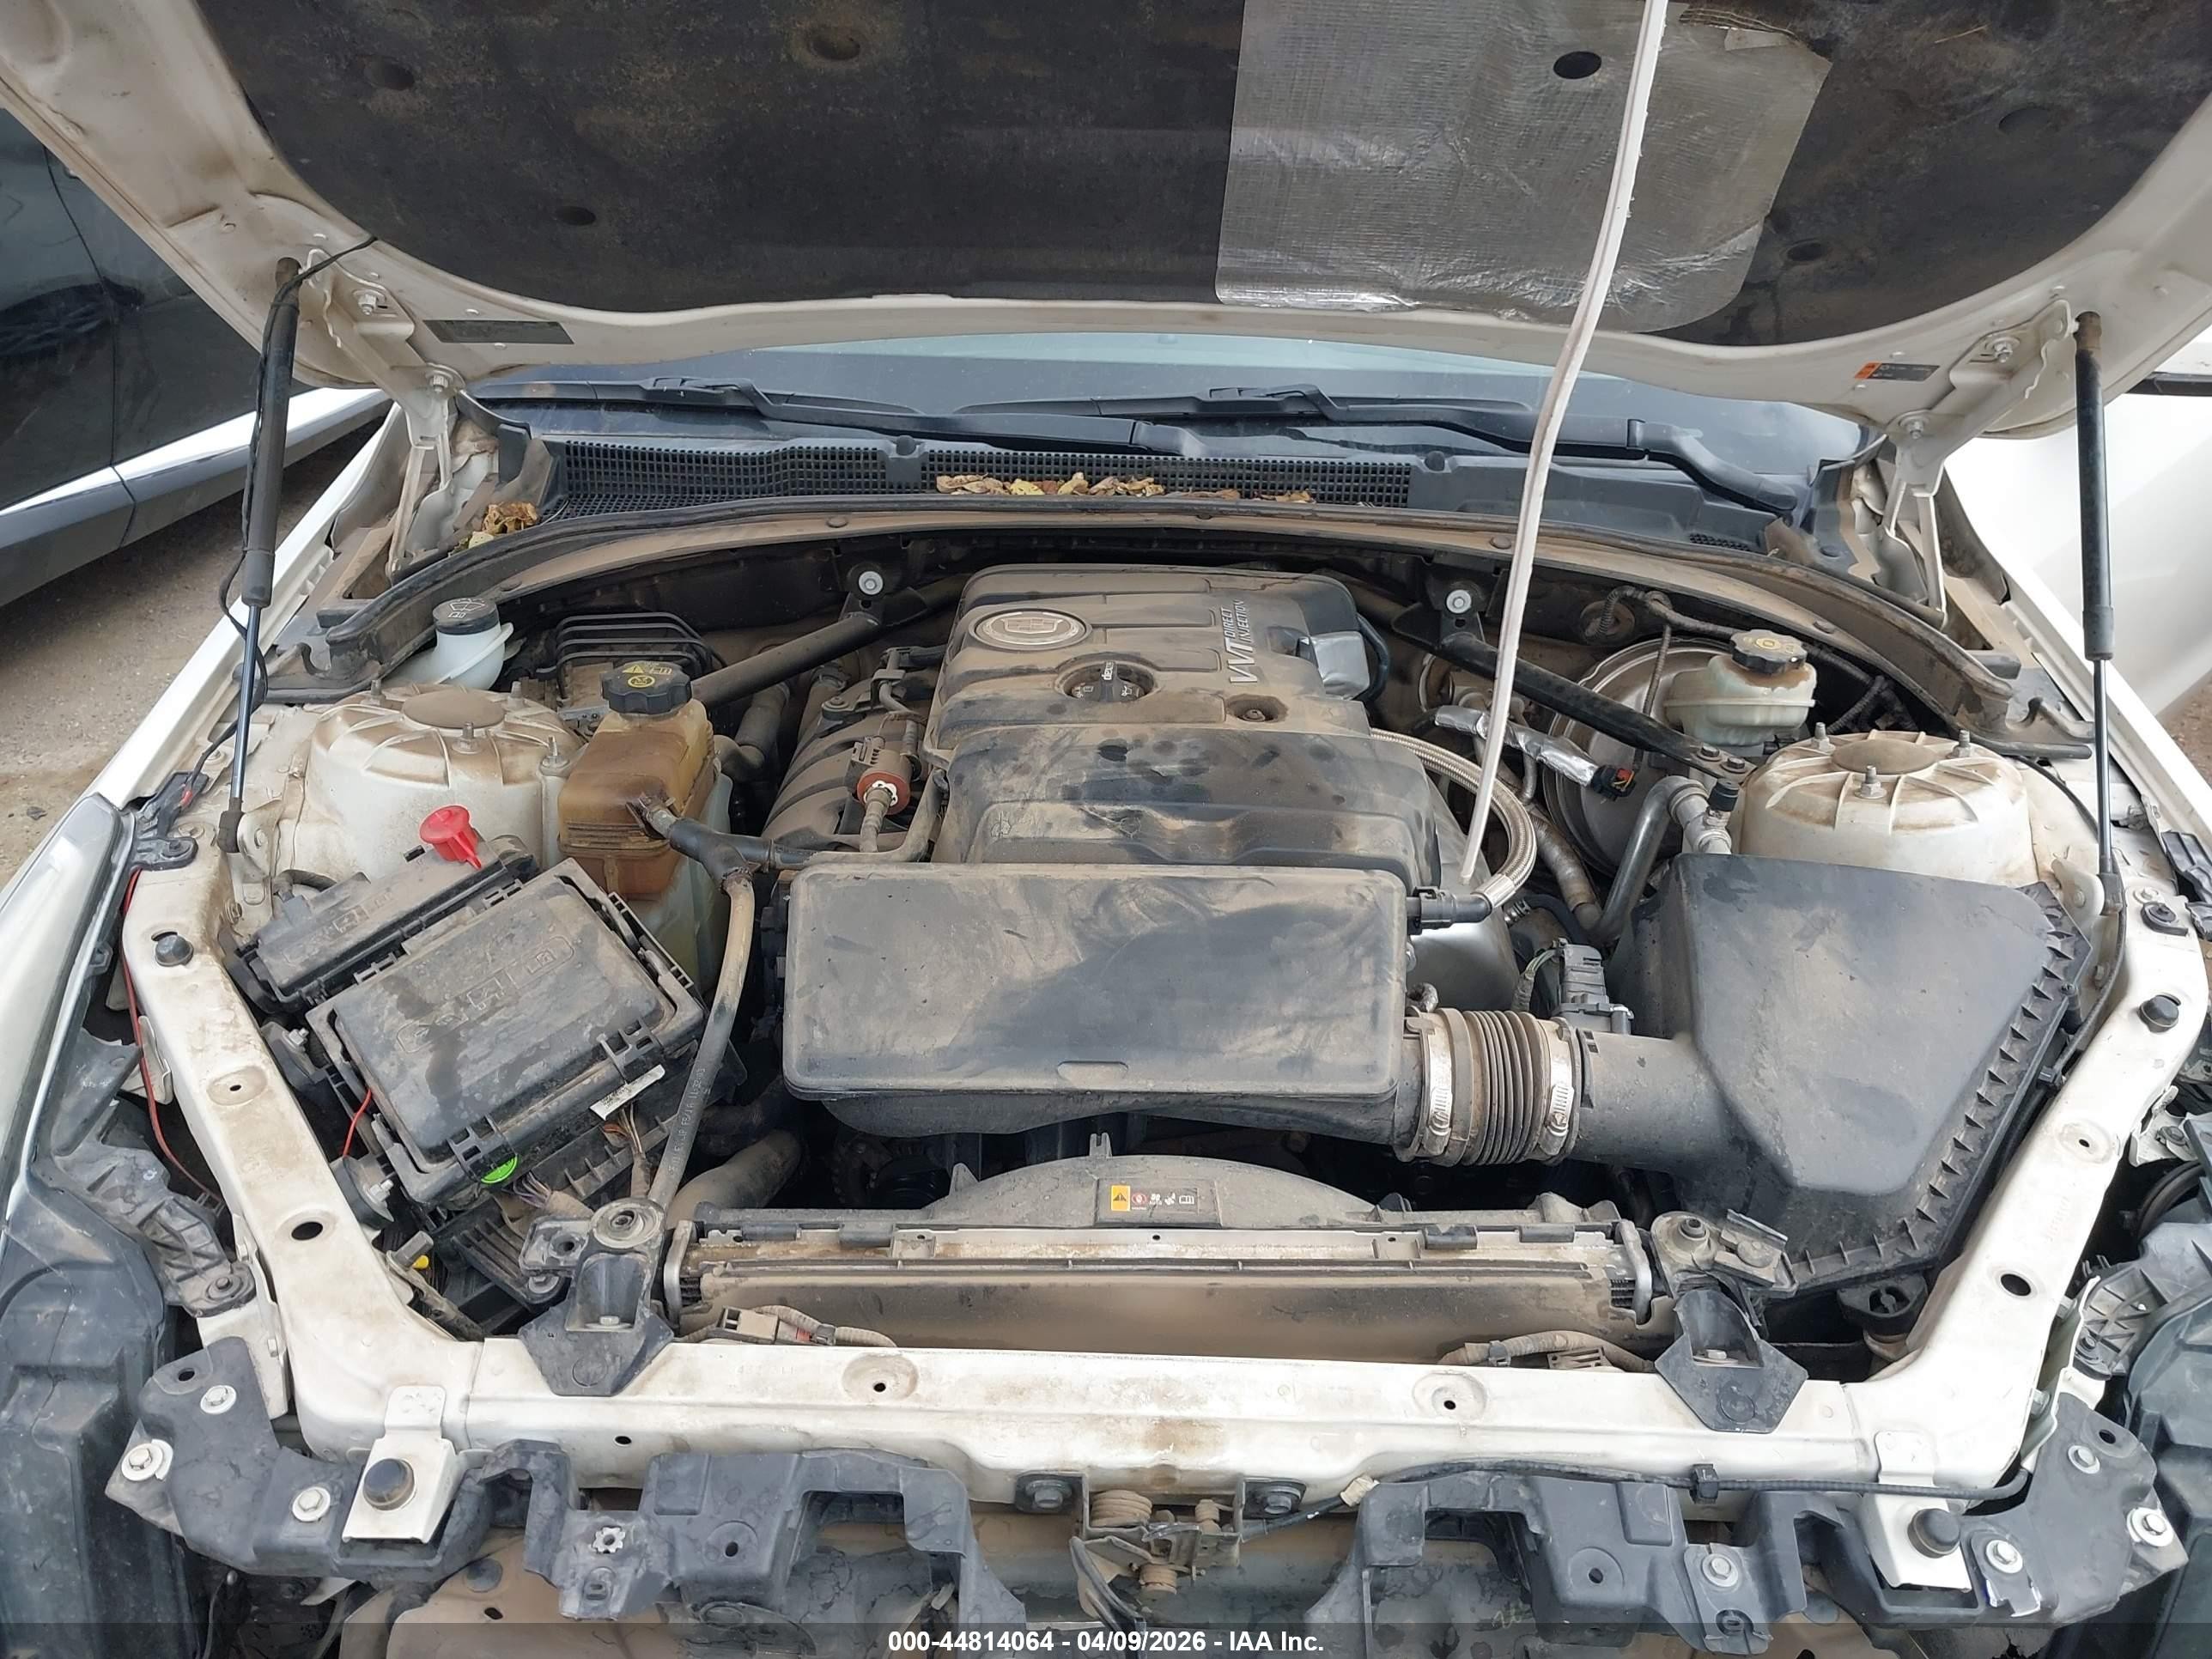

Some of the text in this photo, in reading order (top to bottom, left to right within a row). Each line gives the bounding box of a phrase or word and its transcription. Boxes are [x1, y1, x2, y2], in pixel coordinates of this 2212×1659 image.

[1220, 606, 1237, 639] DIRECT
[1234, 599, 1253, 643] INJECTION
[1224, 637, 1258, 684] VVT
